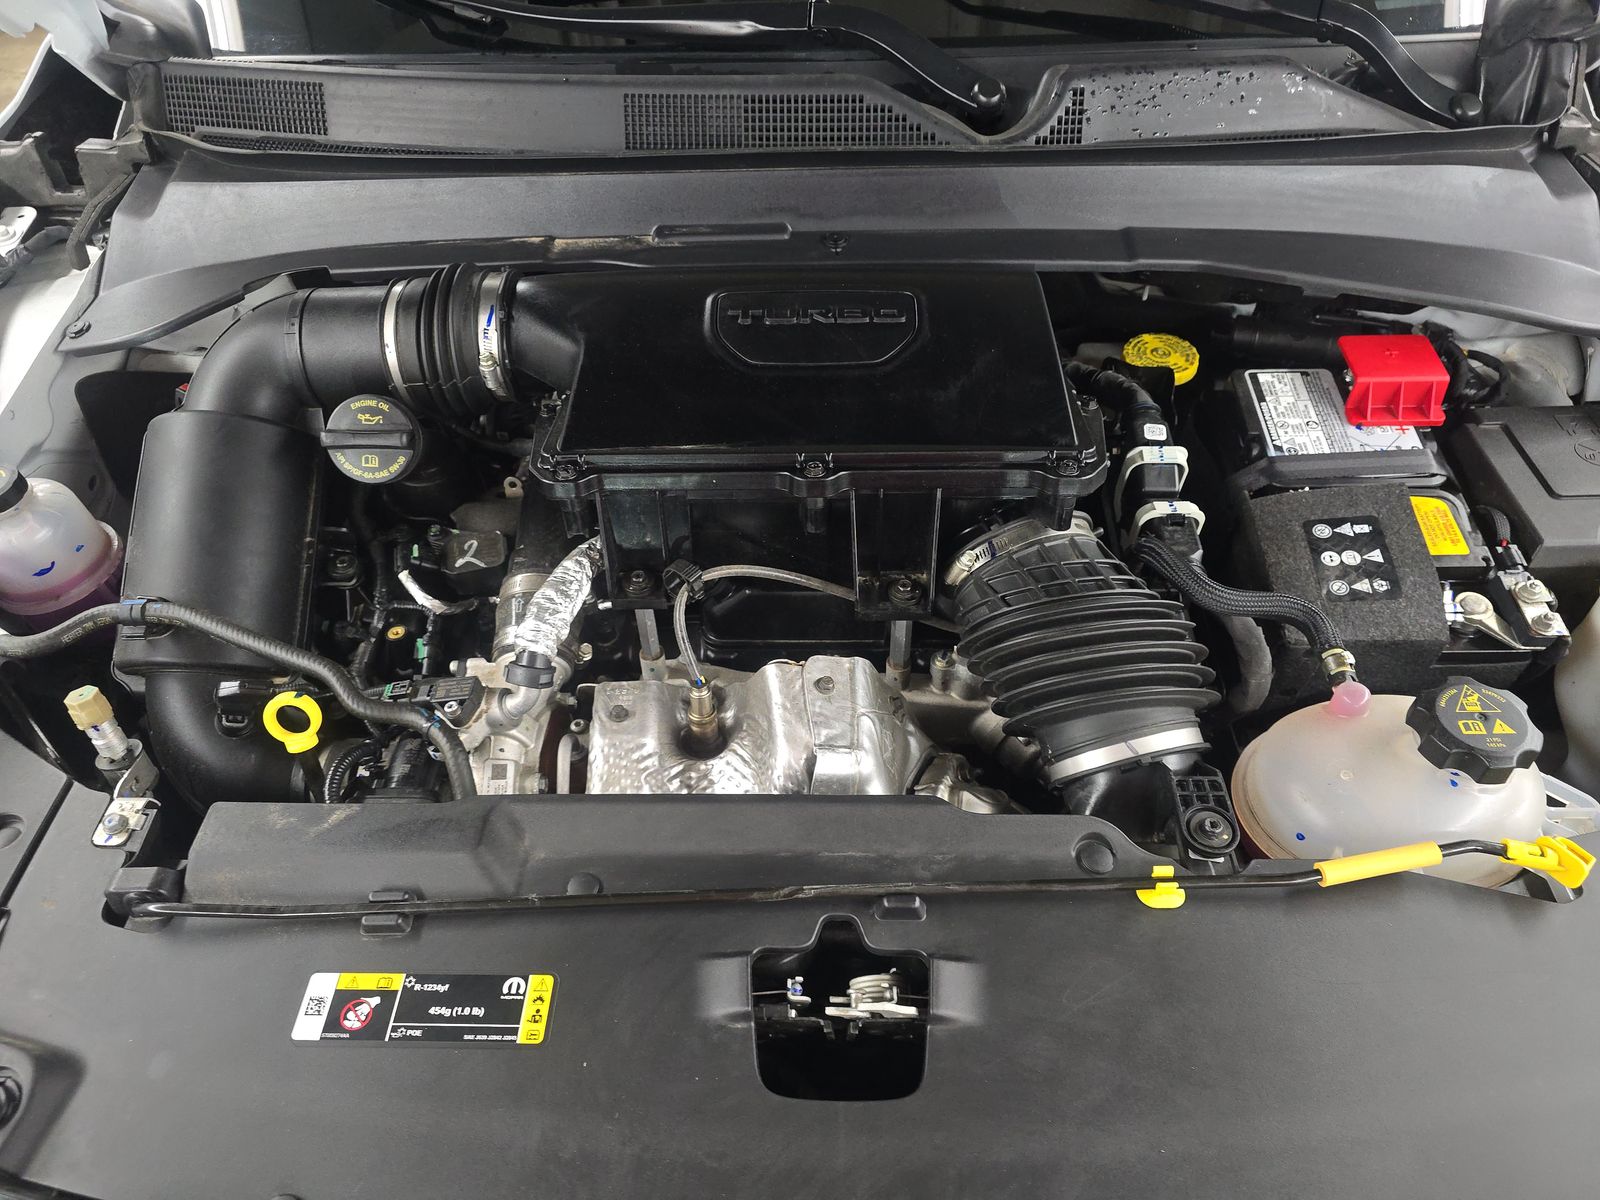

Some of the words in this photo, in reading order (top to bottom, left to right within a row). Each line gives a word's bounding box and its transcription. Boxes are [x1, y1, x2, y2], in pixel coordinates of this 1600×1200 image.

[727, 307, 907, 325] TURBO
[350, 400, 377, 410] ENGINE
[378, 401, 390, 412] OIL
[335, 452, 346, 464] API
[455, 539, 487, 567] 2
[414, 983, 450, 993] R-1234yf
[428, 1006, 452, 1017] 454g
[452, 1006, 470, 1017] (1.0
[472, 1007, 485, 1017] lb)
[406, 1029, 423, 1037] POE
